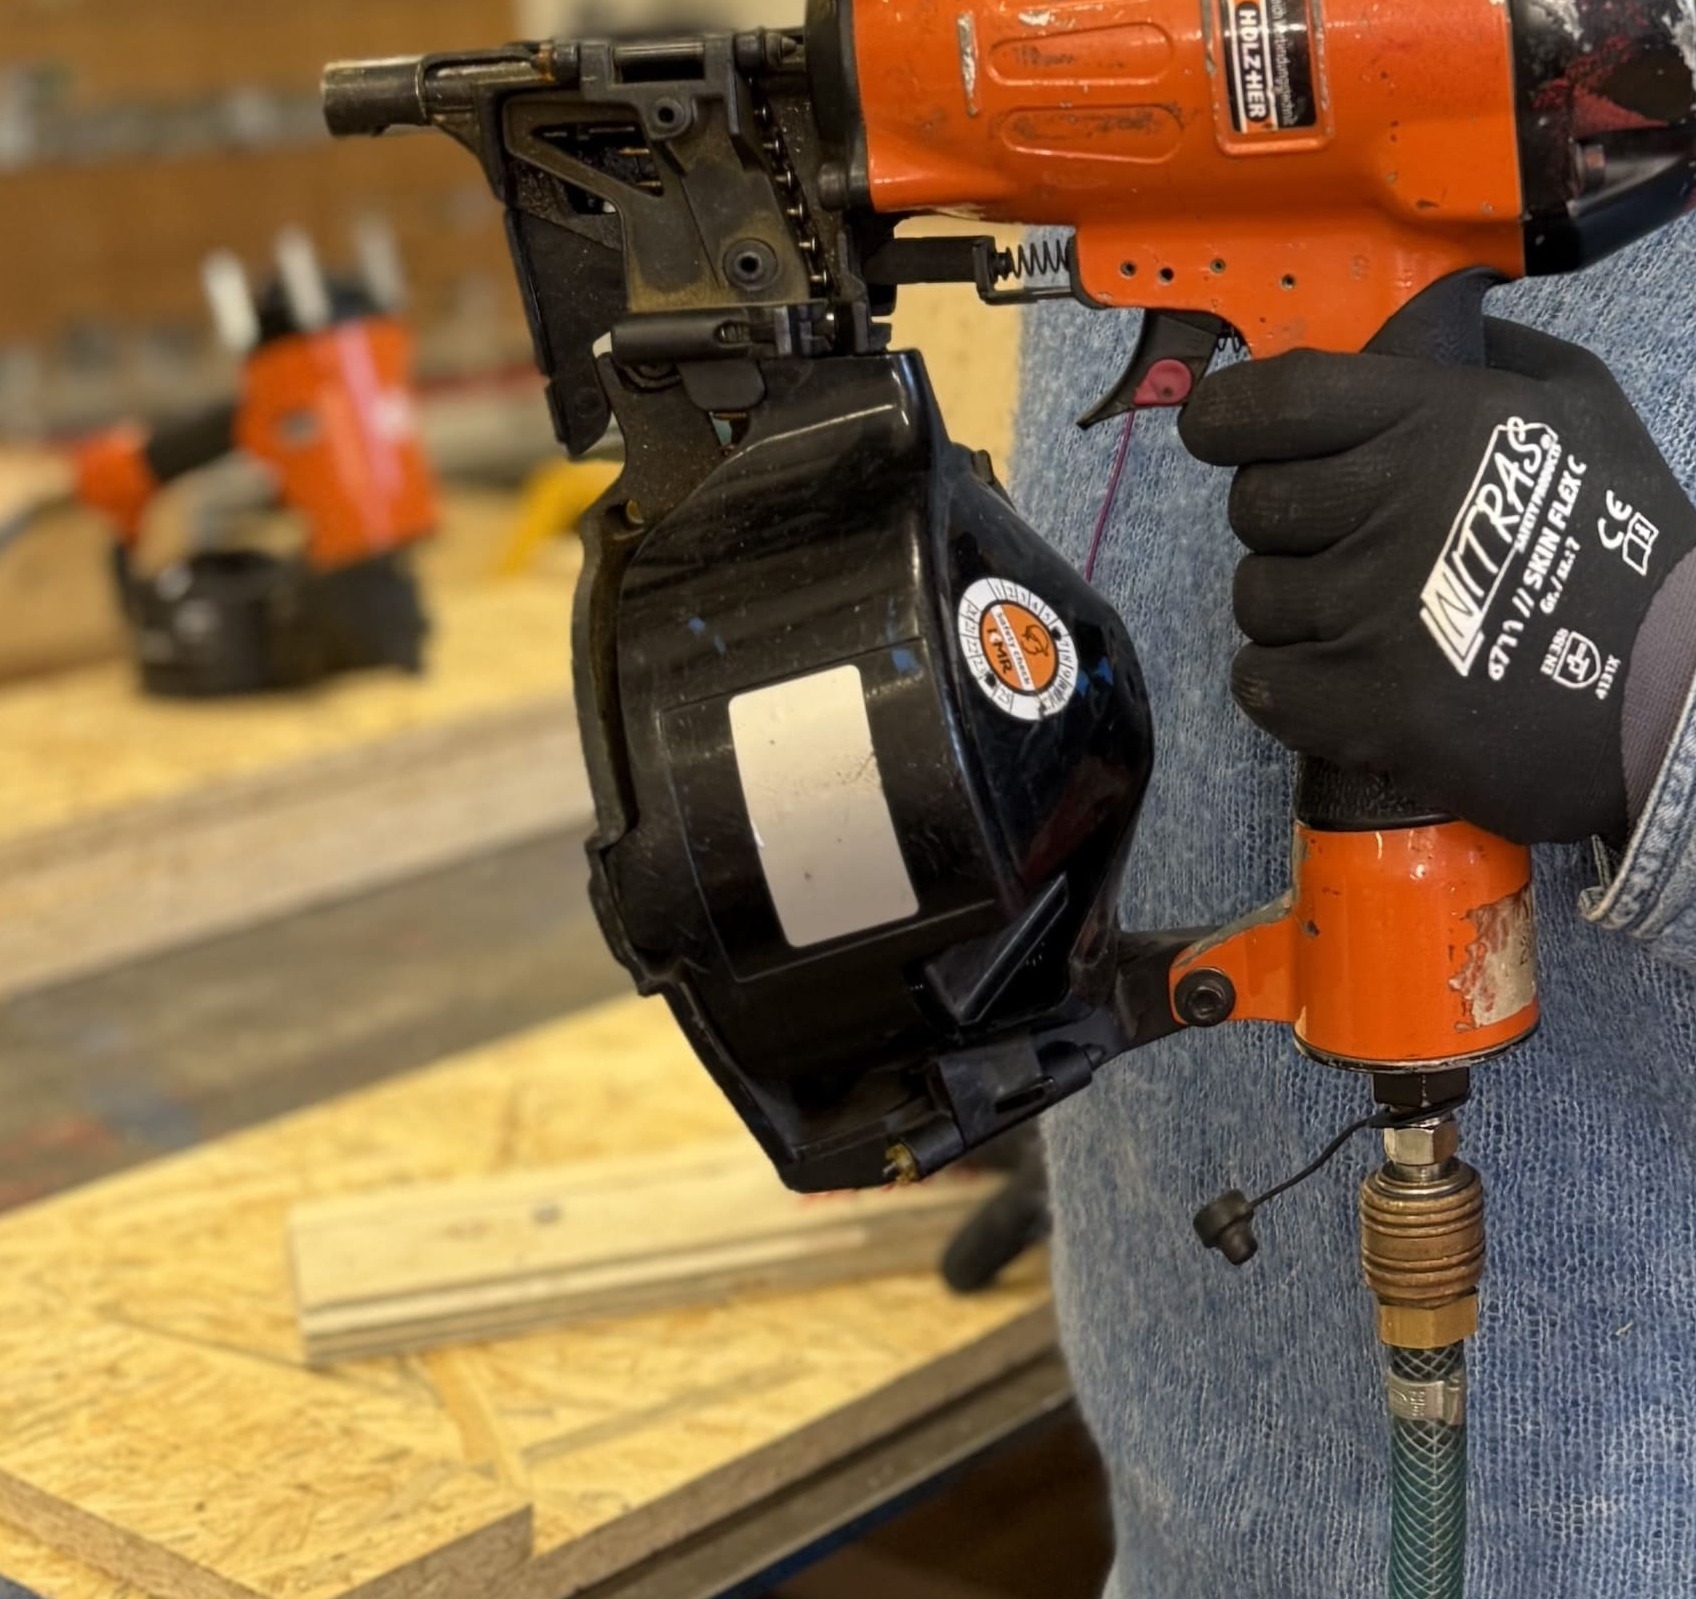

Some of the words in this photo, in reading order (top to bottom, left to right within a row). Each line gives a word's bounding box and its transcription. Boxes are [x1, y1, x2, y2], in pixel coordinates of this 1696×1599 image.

[1420, 416, 1549, 675] NITRAS
[1523, 526, 1561, 590] SKIN
[1547, 470, 1582, 531] FLEX
[1567, 454, 1587, 475] C
